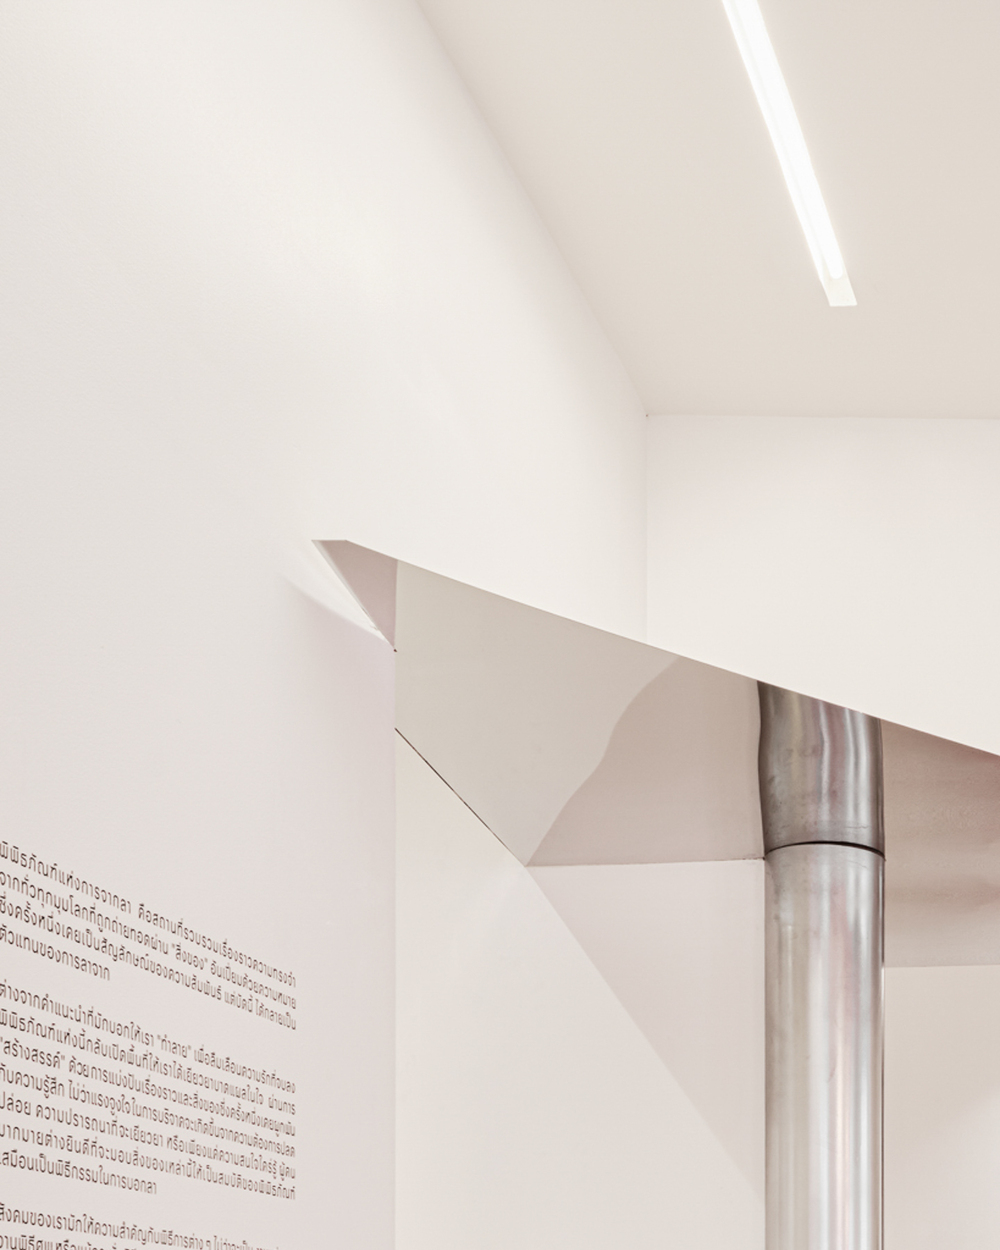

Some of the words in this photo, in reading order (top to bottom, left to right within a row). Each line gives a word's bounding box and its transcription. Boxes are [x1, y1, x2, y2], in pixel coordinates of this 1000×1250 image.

[0, 923, 110, 980] ตัวแทนของการลาจาก
[0, 1149, 156, 1194] สมือนเป็นพิธีกรรมในการบอกลา
